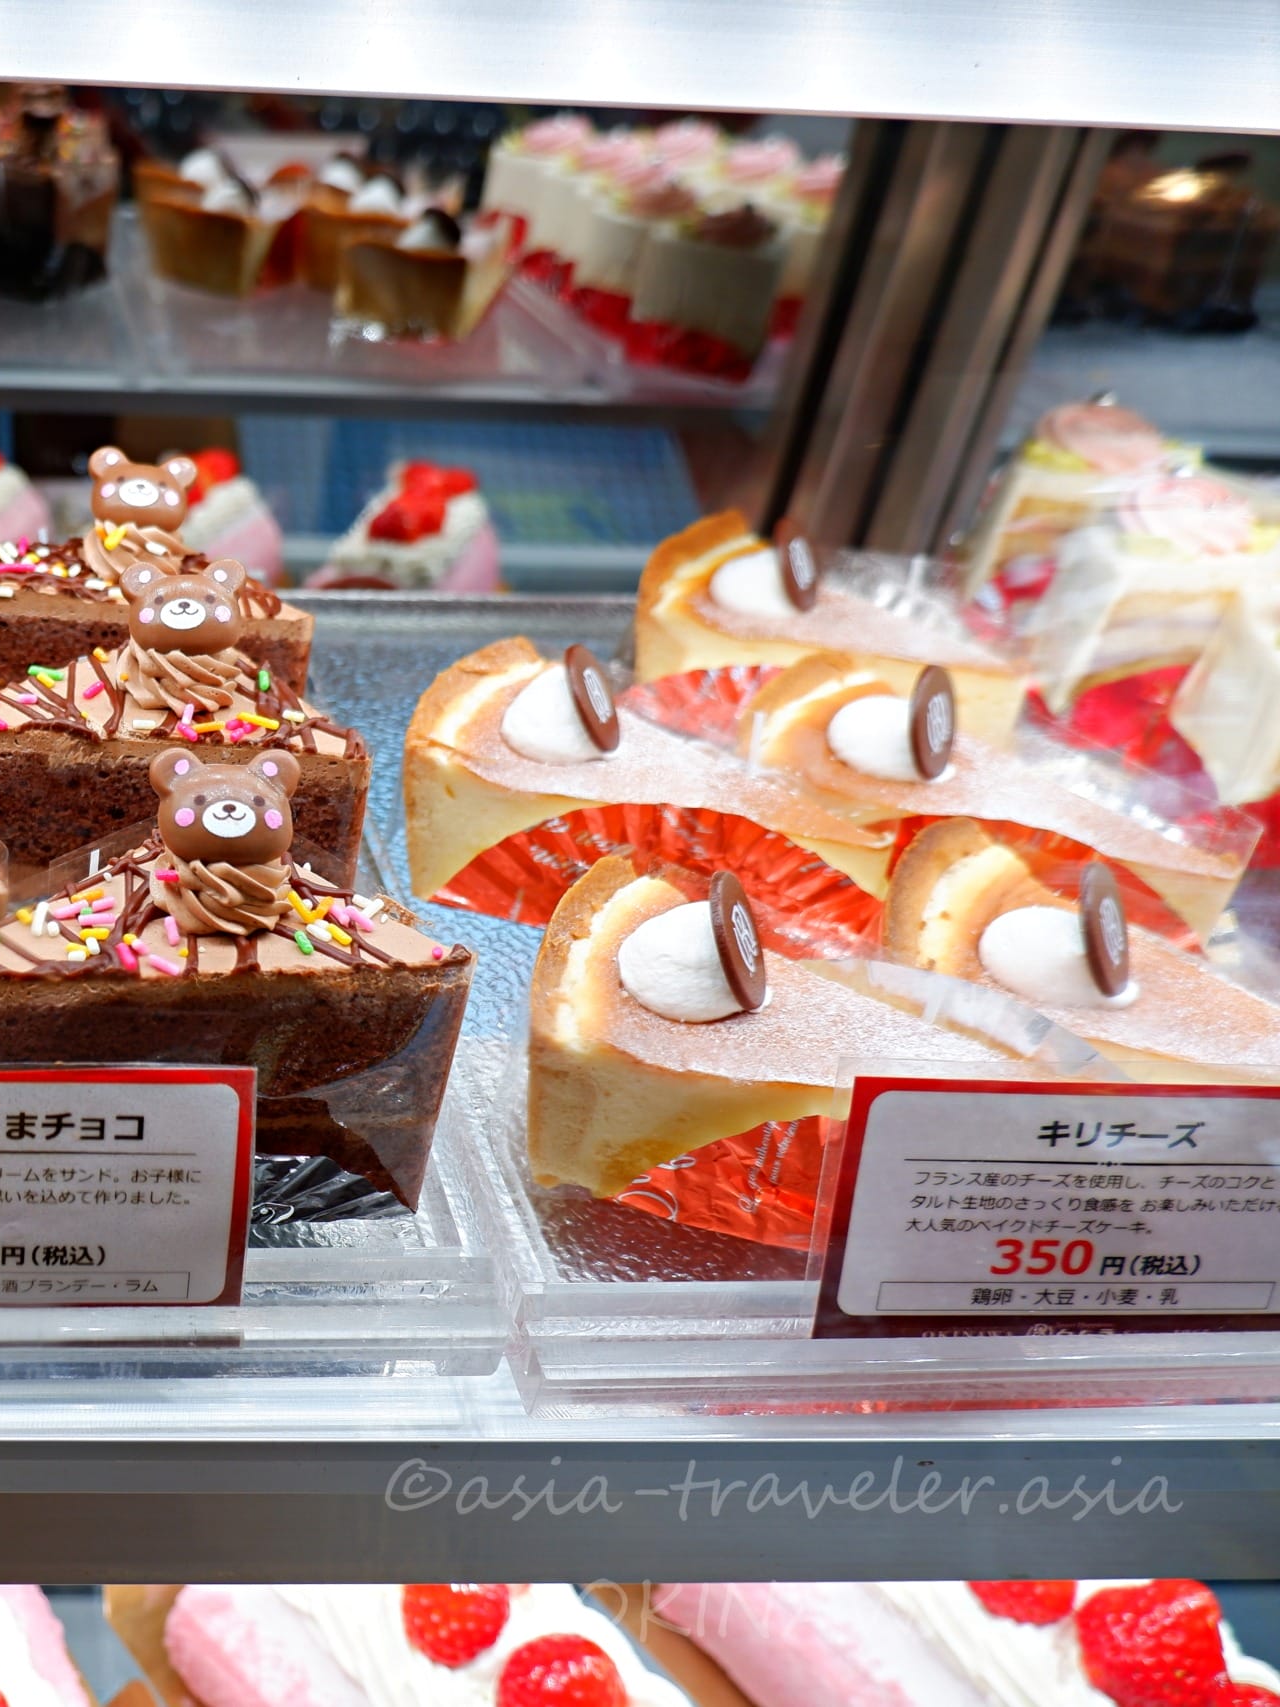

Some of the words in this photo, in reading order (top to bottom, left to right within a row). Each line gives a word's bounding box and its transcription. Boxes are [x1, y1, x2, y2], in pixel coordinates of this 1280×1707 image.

[1037, 1120, 1206, 1148] キリチーズ
[989, 1238, 1094, 1276] 350
